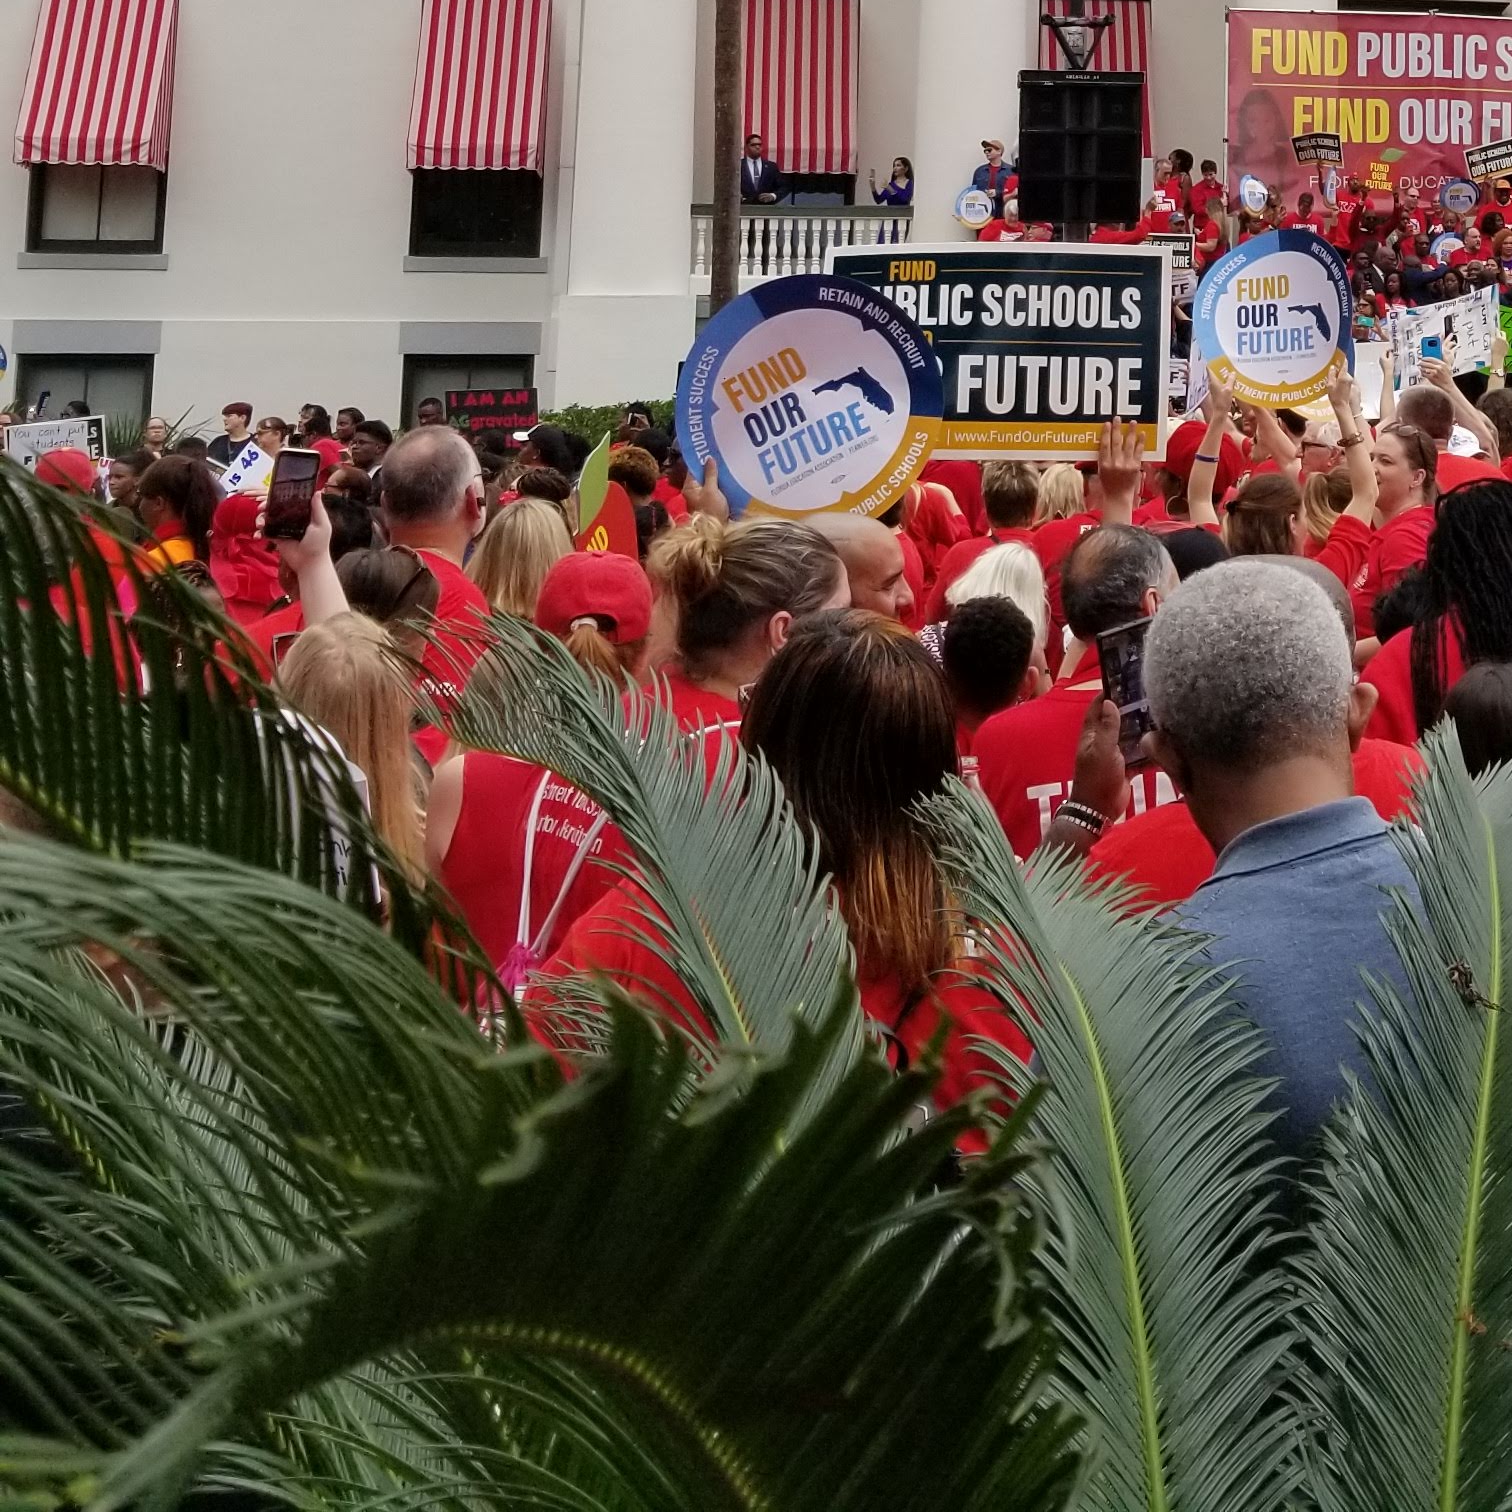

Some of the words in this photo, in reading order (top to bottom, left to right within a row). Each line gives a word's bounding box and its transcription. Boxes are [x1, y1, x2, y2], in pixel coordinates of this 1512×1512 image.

[1251, 28, 1348, 77] FUND
[1357, 31, 1488, 80] PUBLIC
[1293, 96, 1390, 144] FUND
[1399, 98, 1473, 145] OUR
[1299, 149, 1316, 161] OUR
[1371, 163, 1389, 172] FUND
[1471, 164, 1486, 177] OUR
[1365, 180, 1392, 191] FUTURE
[889, 260, 936, 282] FUND
[1201, 282, 1219, 320] STUDENT
[1213, 253, 1247, 285] SUCCESS
[1237, 274, 1290, 302] FUND
[1311, 242, 1333, 266] RETAIN
[1330, 262, 1342, 280] AND
[1338, 279, 1349, 317] RECRUIT
[872, 284, 973, 326] BLIC
[982, 284, 1142, 330] SCHOOLS
[1237, 303, 1279, 329] OUR
[818, 287, 864, 310] RETAIN
[863, 302, 890, 323] AND
[887, 319, 925, 369] RECRUIT
[1237, 325, 1315, 355] FUTURE
[689, 346, 719, 405] SUCCESS
[721, 347, 807, 414] FUND
[956, 354, 1143, 416] FUTURE
[1219, 366, 1271, 401] INSTMENT
[1270, 392, 1279, 402] IN
[1281, 387, 1314, 403] PUBLIC
[450, 392, 458, 407] I
[464, 392, 495, 406] AM
[502, 391, 529, 405] AN
[13, 428, 30, 438] You
[68, 425, 85, 437] put
[689, 407, 712, 466] STUDENT
[743, 391, 807, 448] OUR
[954, 430, 1100, 444] www.FundOurFutureFL
[31, 438, 75, 448] students
[757, 401, 871, 486] FUTURE
[888, 432, 928, 487] SCHOOLS
[228, 473, 241, 486] IS
[241, 449, 259, 470] 46
